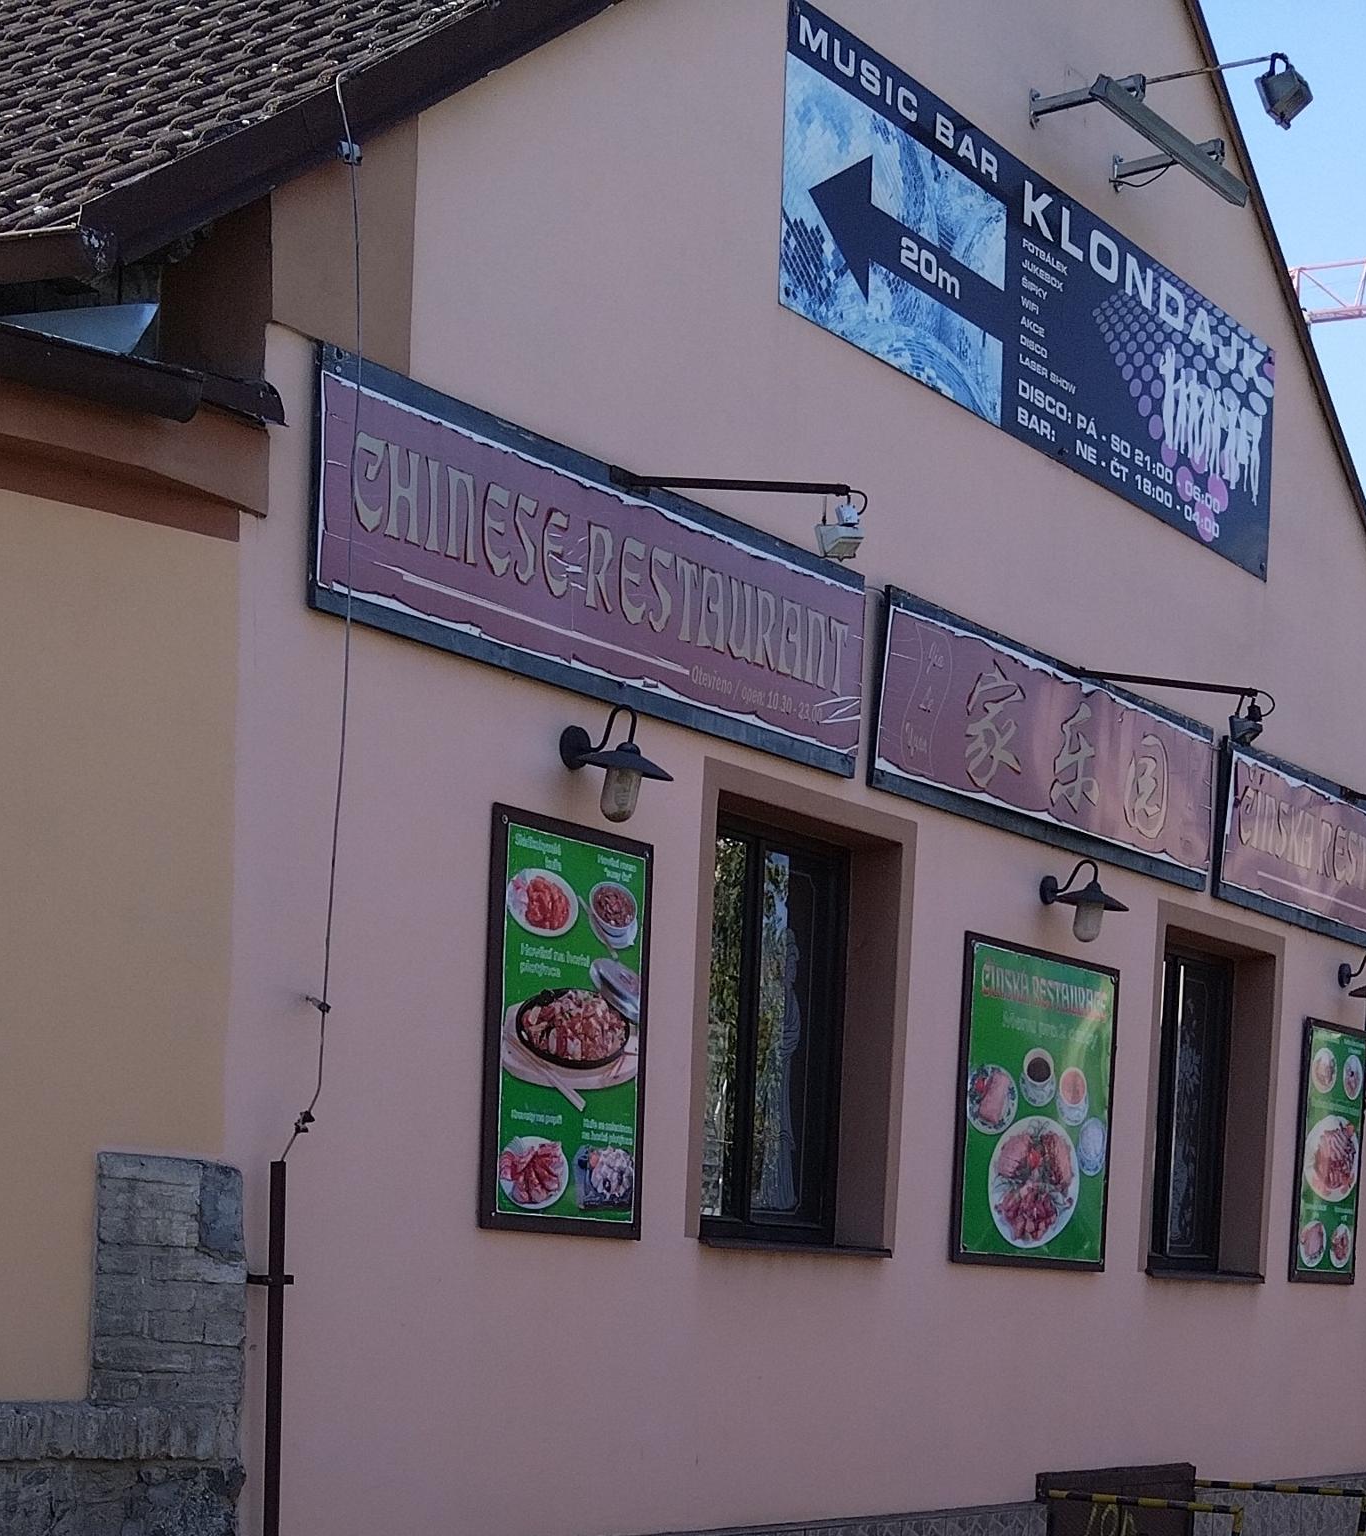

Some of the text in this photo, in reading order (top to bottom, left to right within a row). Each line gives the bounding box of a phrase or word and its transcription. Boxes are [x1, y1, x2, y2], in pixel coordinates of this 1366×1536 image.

[798, 13, 999, 184] MUSIC BAR
[901, 236, 961, 300] 20m
[1022, 238, 1068, 276] FOTBÁLEK
[1022, 259, 1063, 292] JUKEBOX
[1021, 276, 1048, 301] ŠIPKY
[1023, 179, 1265, 382] KLONDAJK
[1021, 295, 1040, 315] WIFI
[1020, 316, 1046, 338] AKCE
[1020, 334, 1048, 359] DISCO
[1019, 354, 1077, 396] LASER SHOW
[1017, 379, 1072, 425] DISCO:
[1077, 416, 1098, 440] PÁ
[1111, 433, 1131, 460] SO
[1134, 449, 1173, 485] 21:00
[1185, 479, 1221, 514] 06:00
[1017, 406, 1055, 443] BAR:
[1075, 439, 1097, 466] NE
[1110, 452, 1129, 484] ČT
[1134, 474, 1173, 509] 18:00
[1184, 504, 1220, 539] 04:00
[353, 431, 849, 697] CHINESE RESTAURANT
[691, 665, 733, 695] Otevřeno
[1032, 976, 1107, 1015] RESTAURACE
